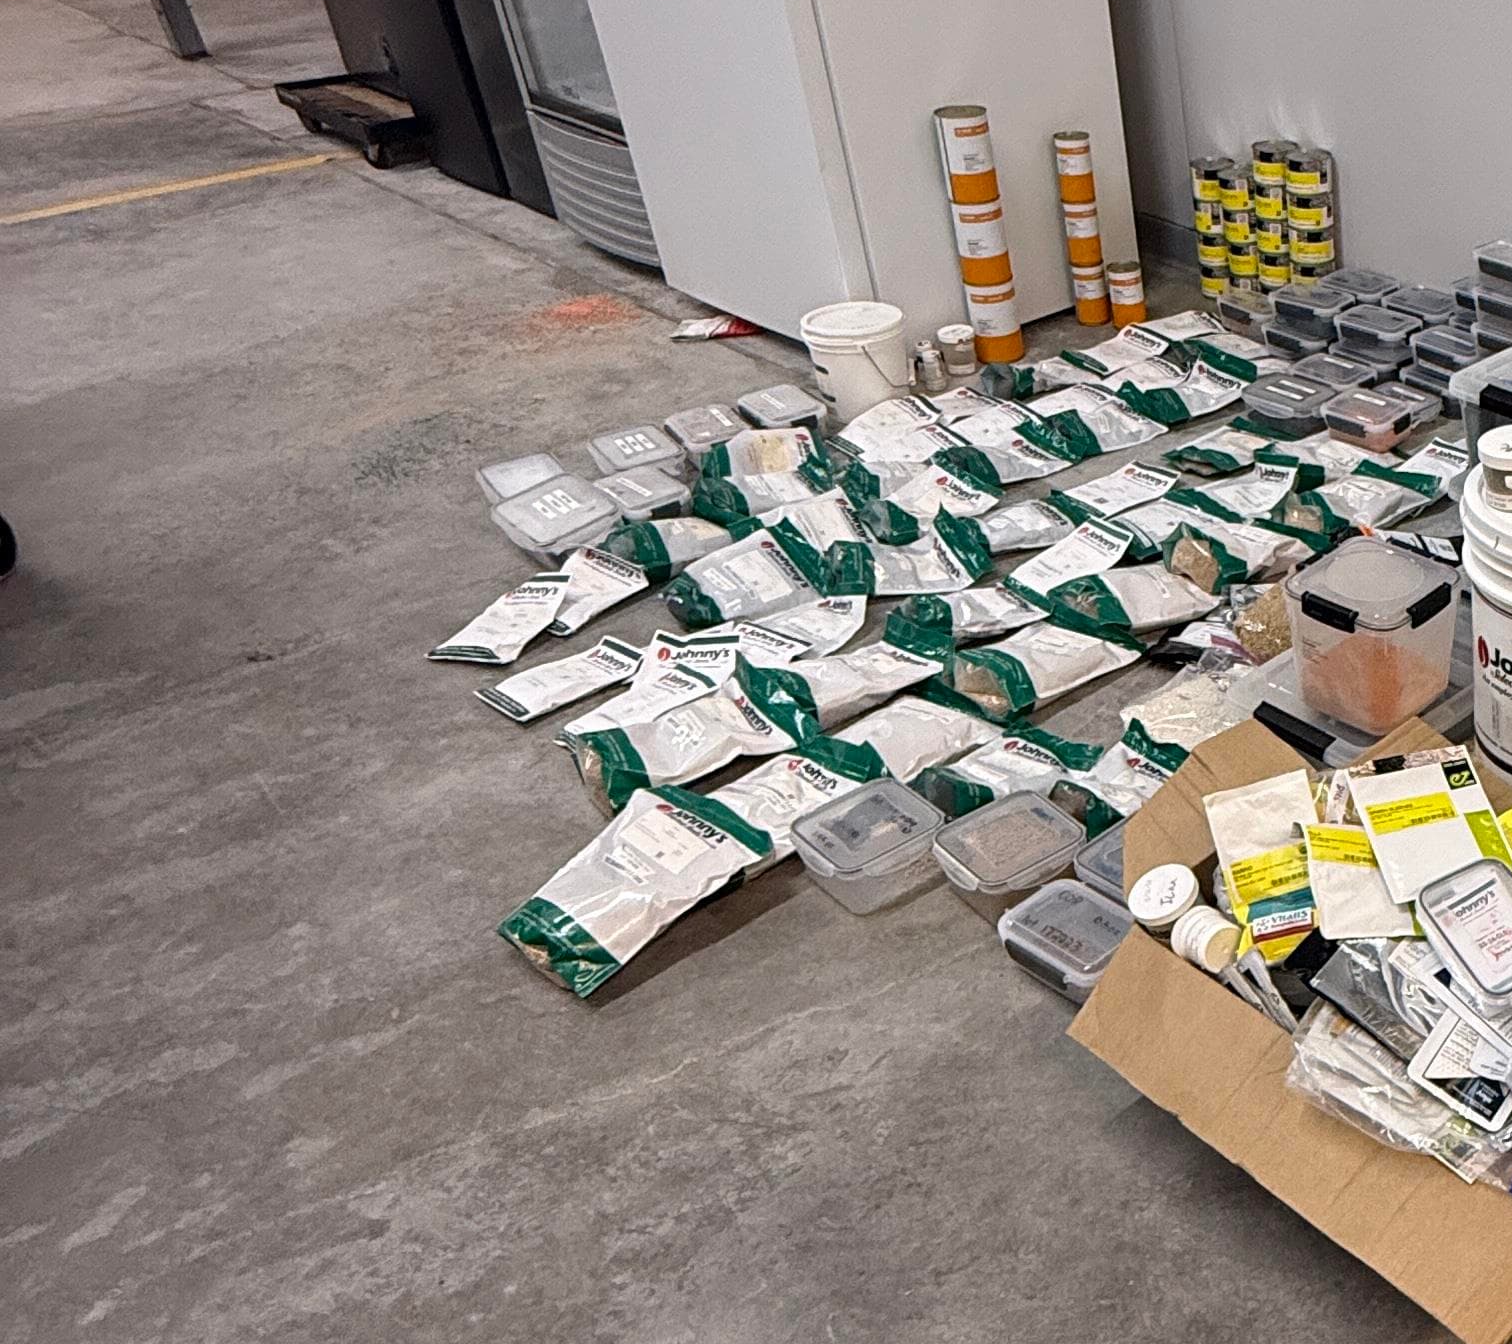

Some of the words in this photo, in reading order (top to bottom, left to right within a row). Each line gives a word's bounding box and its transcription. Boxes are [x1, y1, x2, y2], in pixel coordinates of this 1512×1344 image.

[671, 648, 730, 660] Johnny's
[673, 808, 729, 845] Johnny's
[1454, 889, 1496, 918] ohnny's
